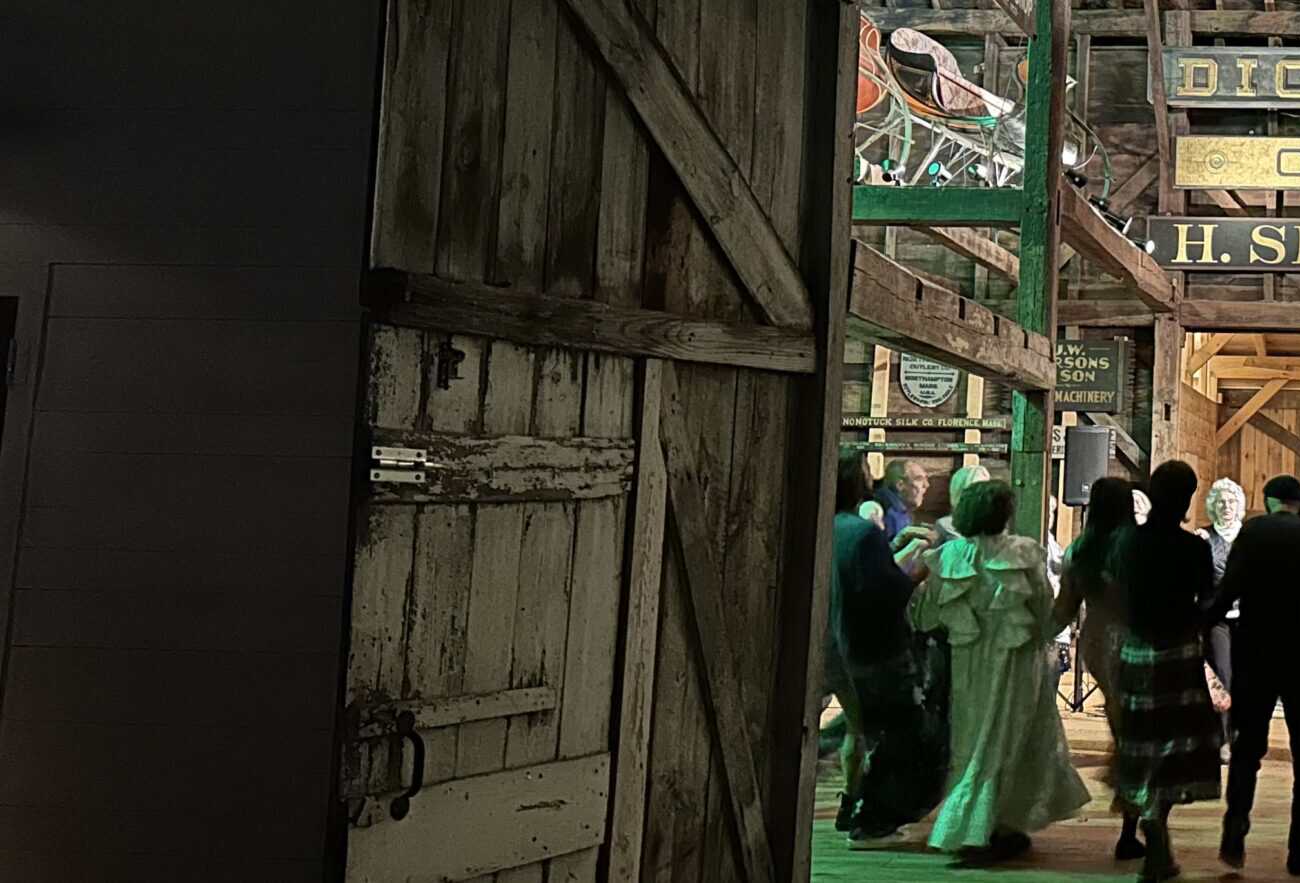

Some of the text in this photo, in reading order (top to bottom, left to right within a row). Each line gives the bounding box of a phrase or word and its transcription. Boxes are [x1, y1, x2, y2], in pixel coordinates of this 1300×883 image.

[1170, 223, 1232, 264] H.
[1055, 344, 1086, 356] J.W.
[1060, 370, 1096, 382] SON
[1054, 390, 1116, 403] MACHINERY
[842, 417, 893, 427] NONOTUCK
[895, 417, 919, 427] SILK
[937, 418, 980, 428] FLORENCE
